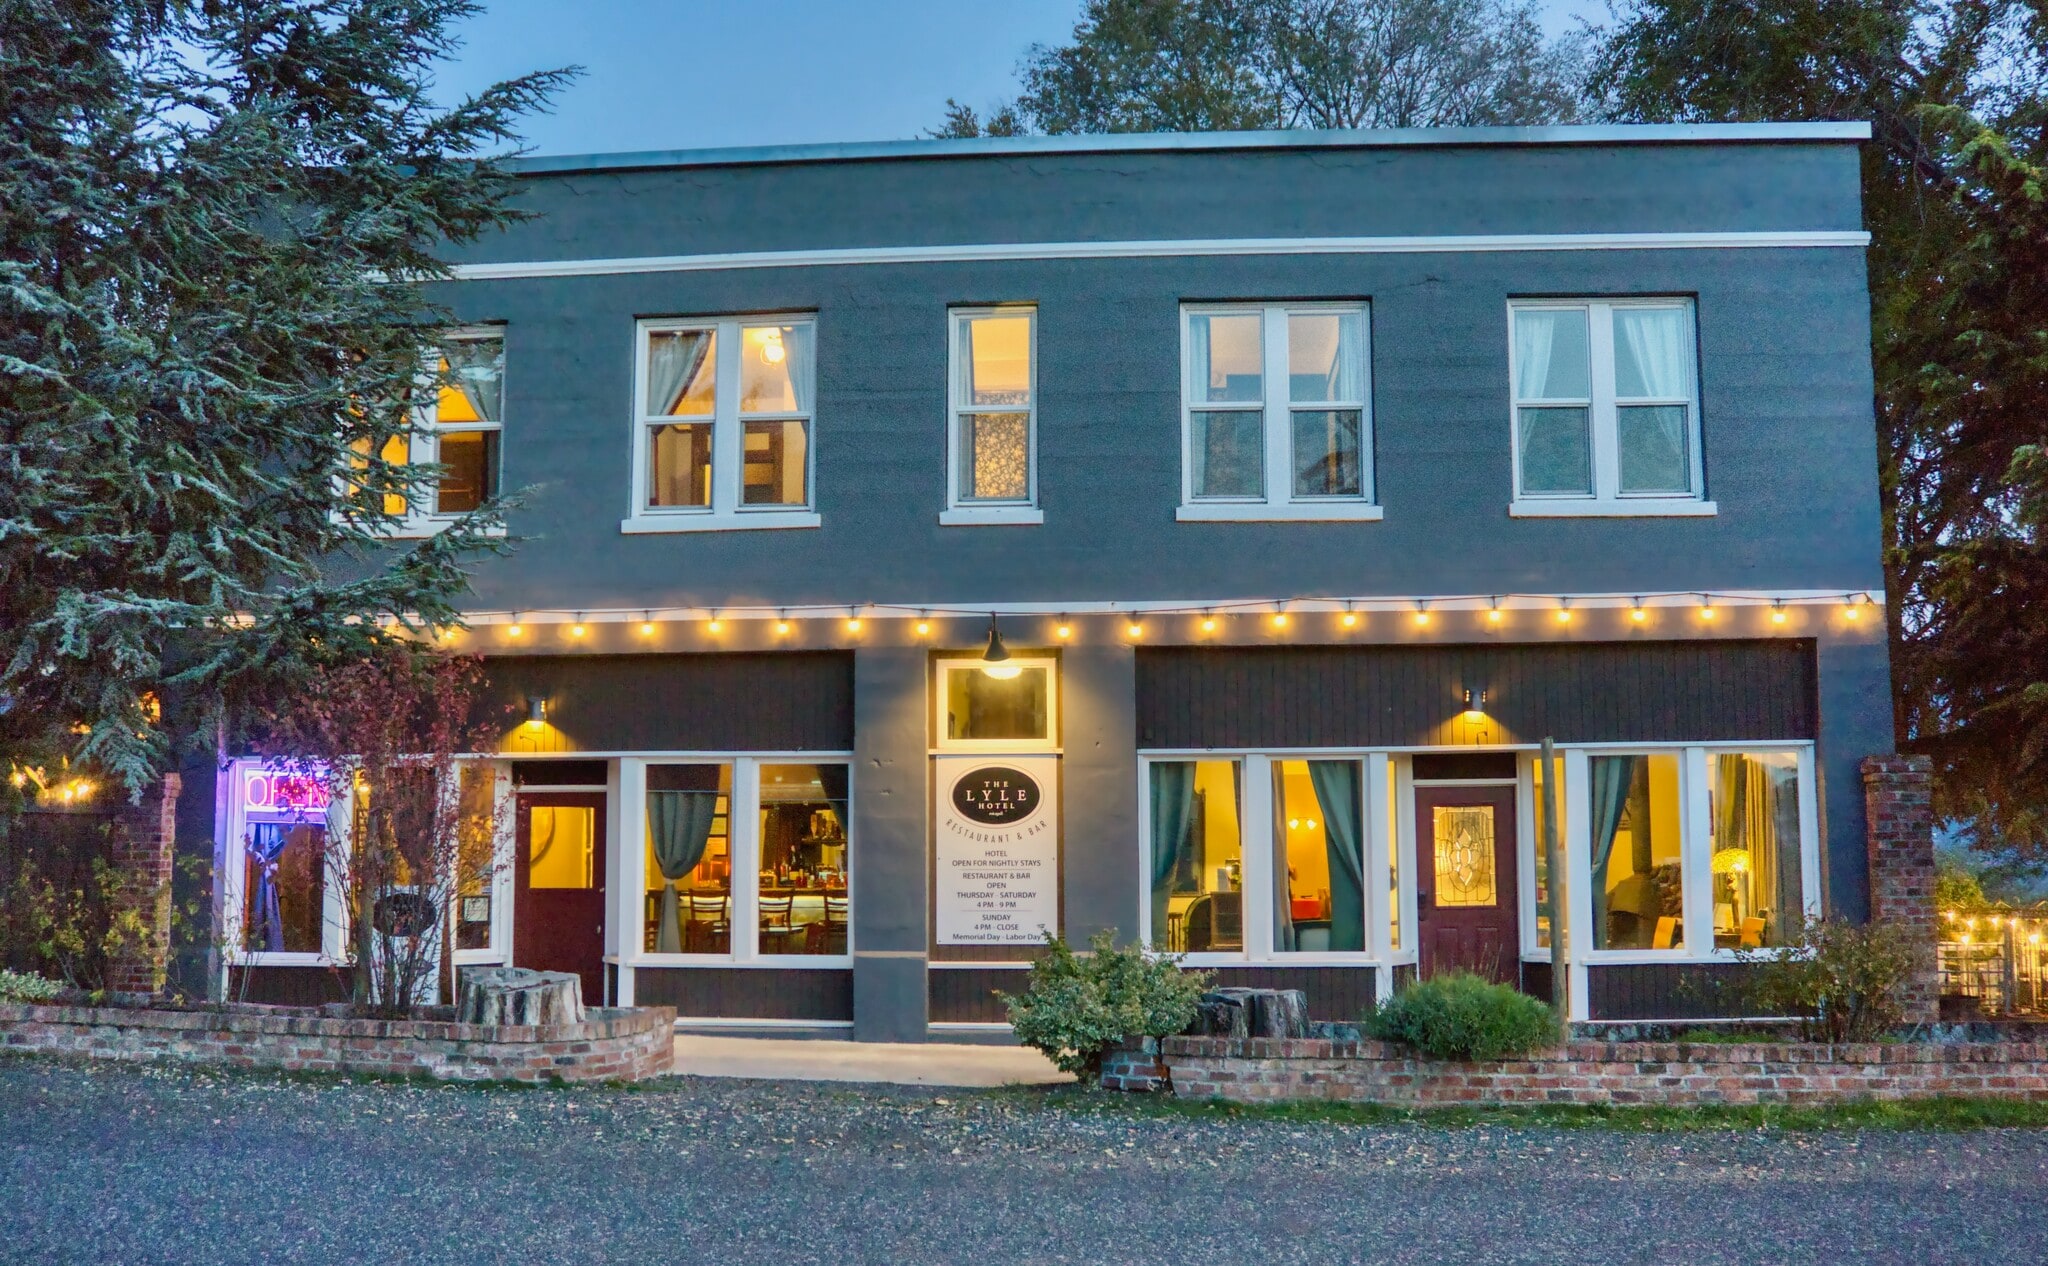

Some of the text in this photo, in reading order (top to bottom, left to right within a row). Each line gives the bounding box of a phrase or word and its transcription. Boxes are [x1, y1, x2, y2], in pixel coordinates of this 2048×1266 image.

[966, 789, 1027, 801] LYLE
[946, 818, 1048, 843] RESTAURANT & BAR
